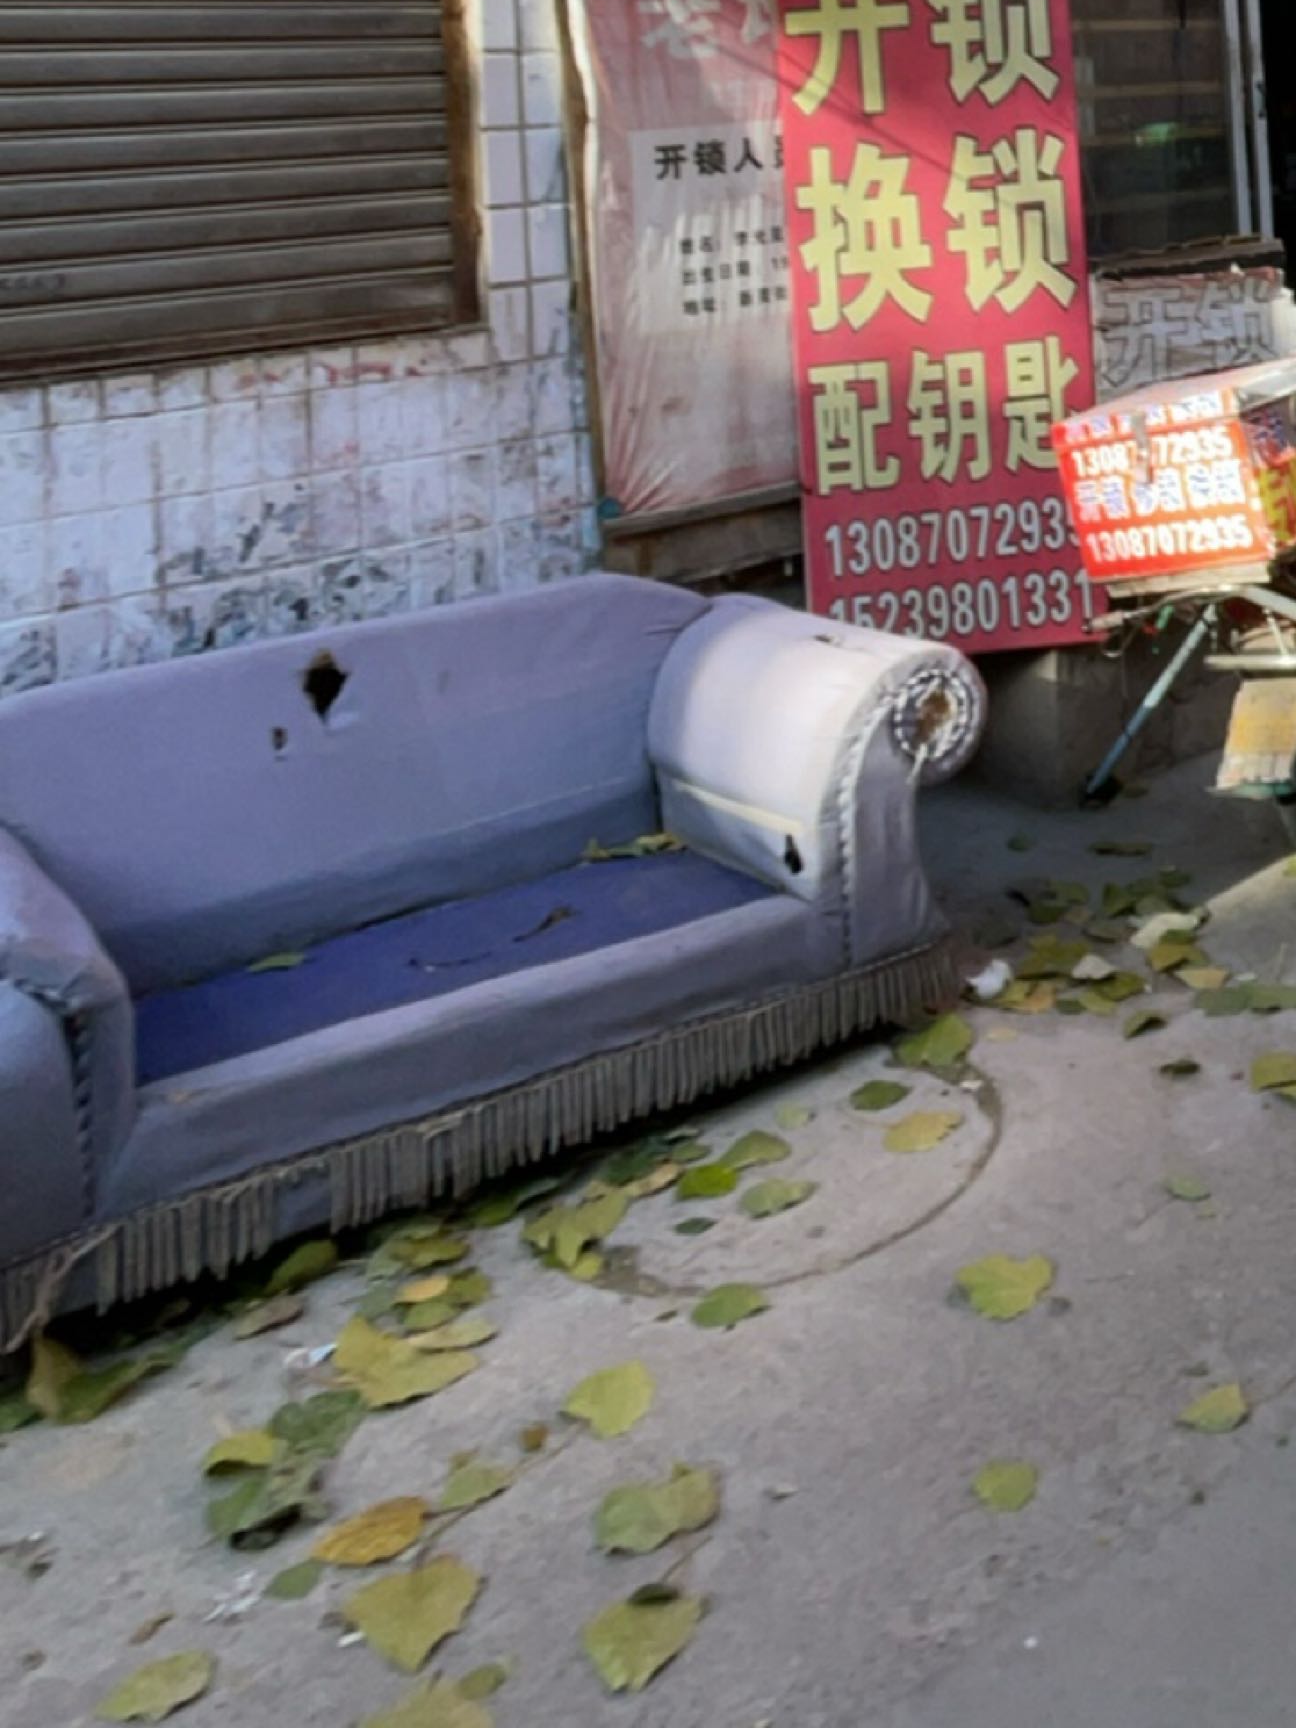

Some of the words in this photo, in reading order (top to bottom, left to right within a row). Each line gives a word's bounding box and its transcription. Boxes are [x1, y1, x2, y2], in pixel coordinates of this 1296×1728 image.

[795, 127, 1078, 332] 换锁
[1095, 280, 1279, 388] 开锁
[806, 335, 1082, 496] 配钥匙
[1072, 425, 1233, 476] 1308772935
[825, 496, 1080, 577] 1308707293
[1086, 514, 1254, 563] 13087072935
